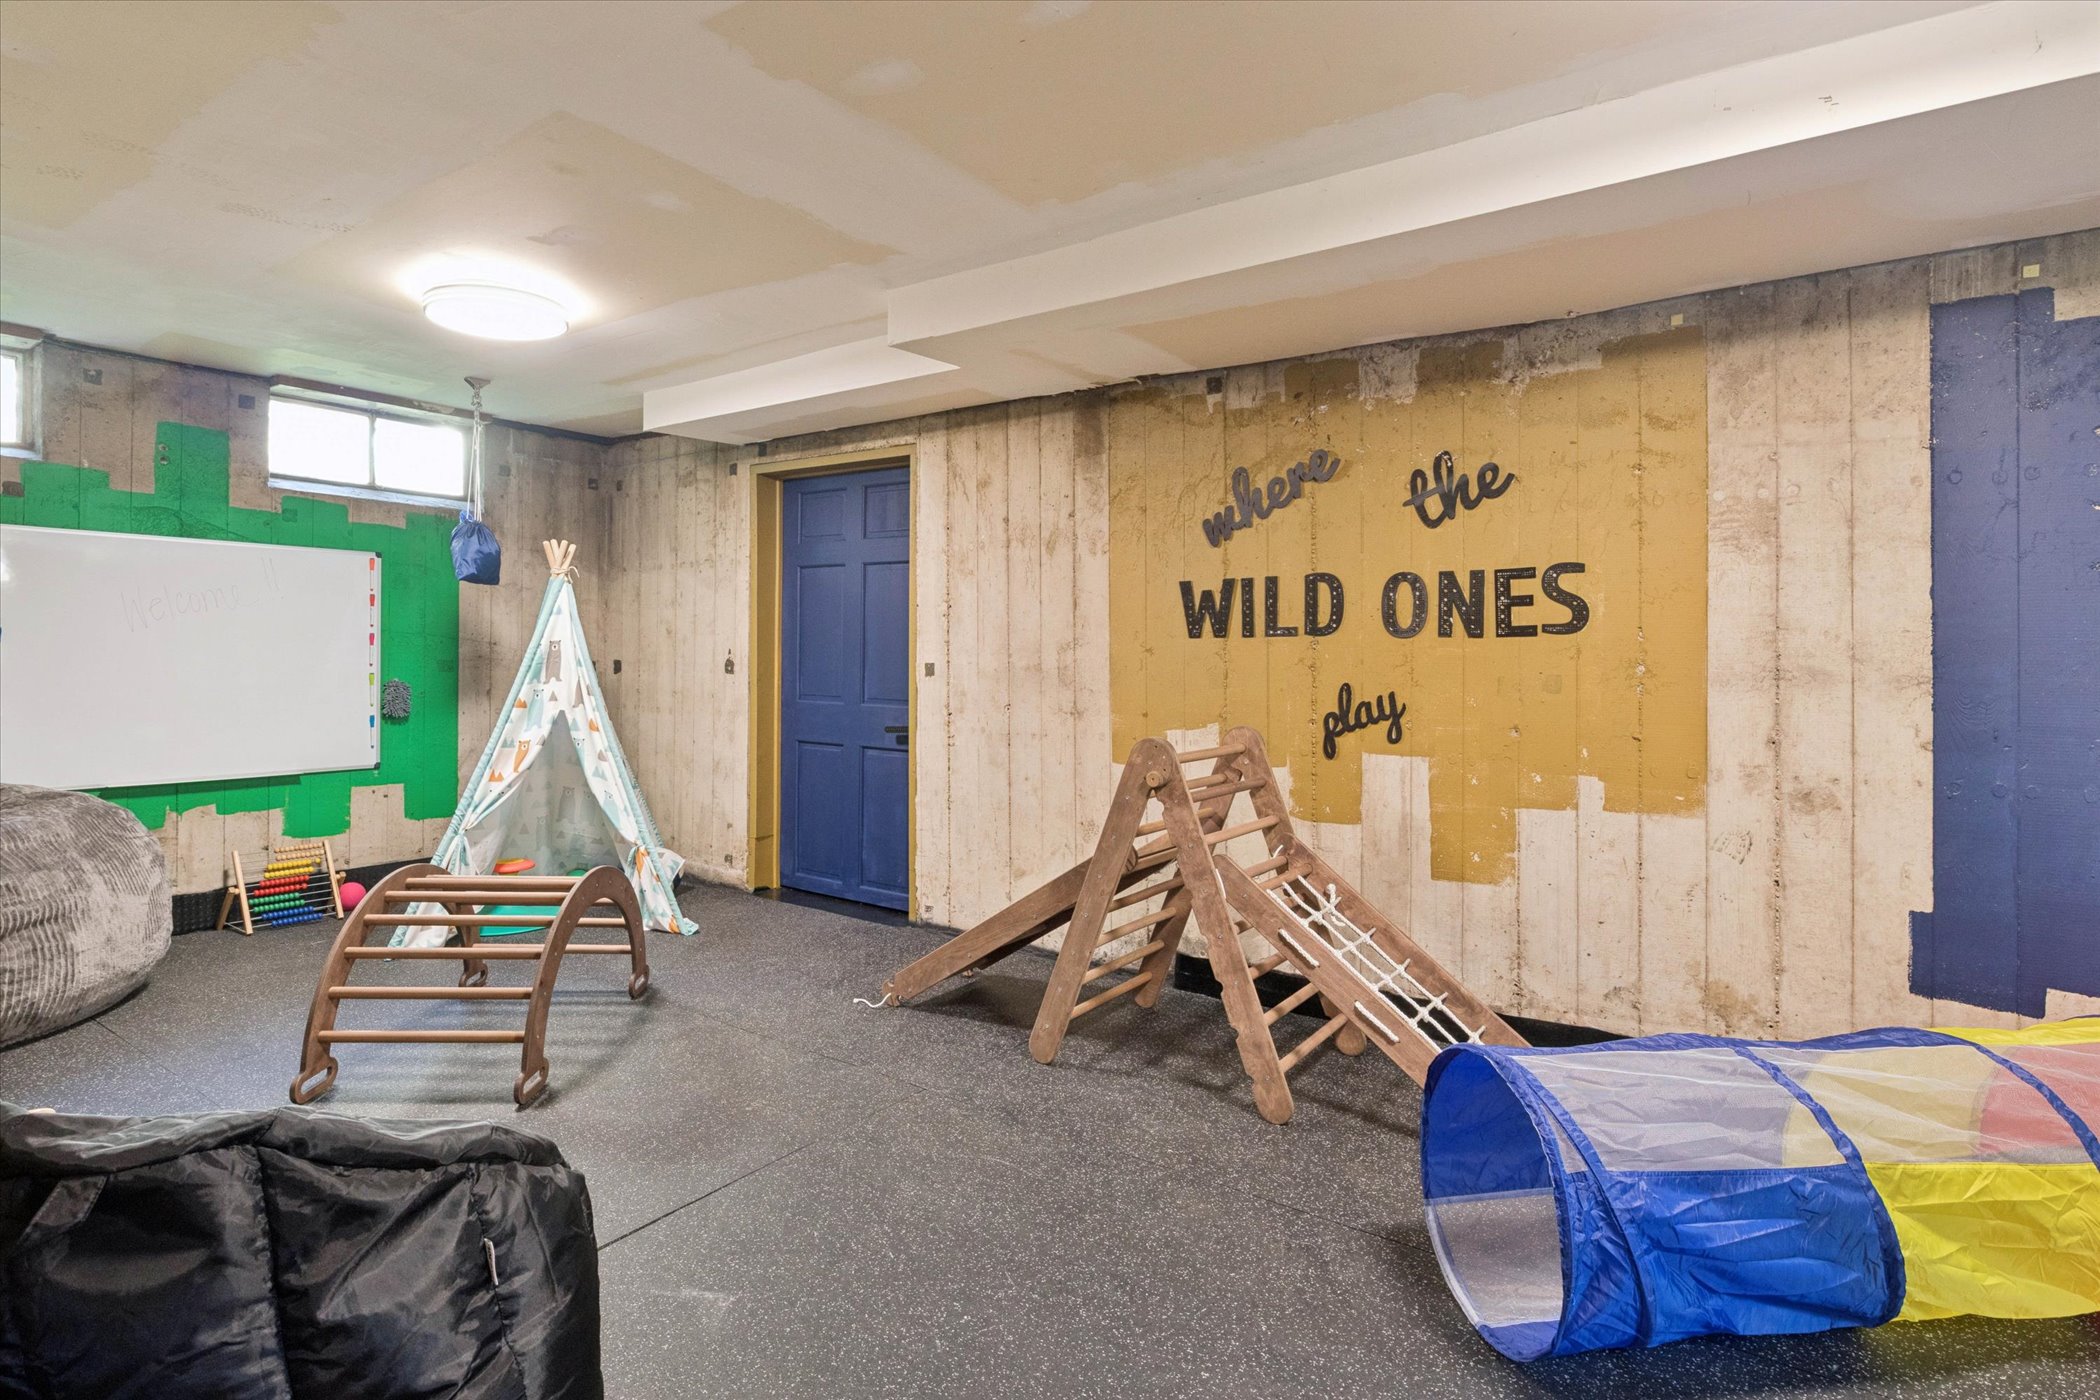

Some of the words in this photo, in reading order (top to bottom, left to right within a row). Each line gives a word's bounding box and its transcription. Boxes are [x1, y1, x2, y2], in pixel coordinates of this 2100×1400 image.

[1202, 449, 1341, 548] where
[1402, 450, 1515, 529] the
[120, 580, 260, 633] Welcome
[1179, 571, 1345, 639] WILD
[1381, 562, 1590, 638] ONES
[1323, 682, 1407, 760] play
